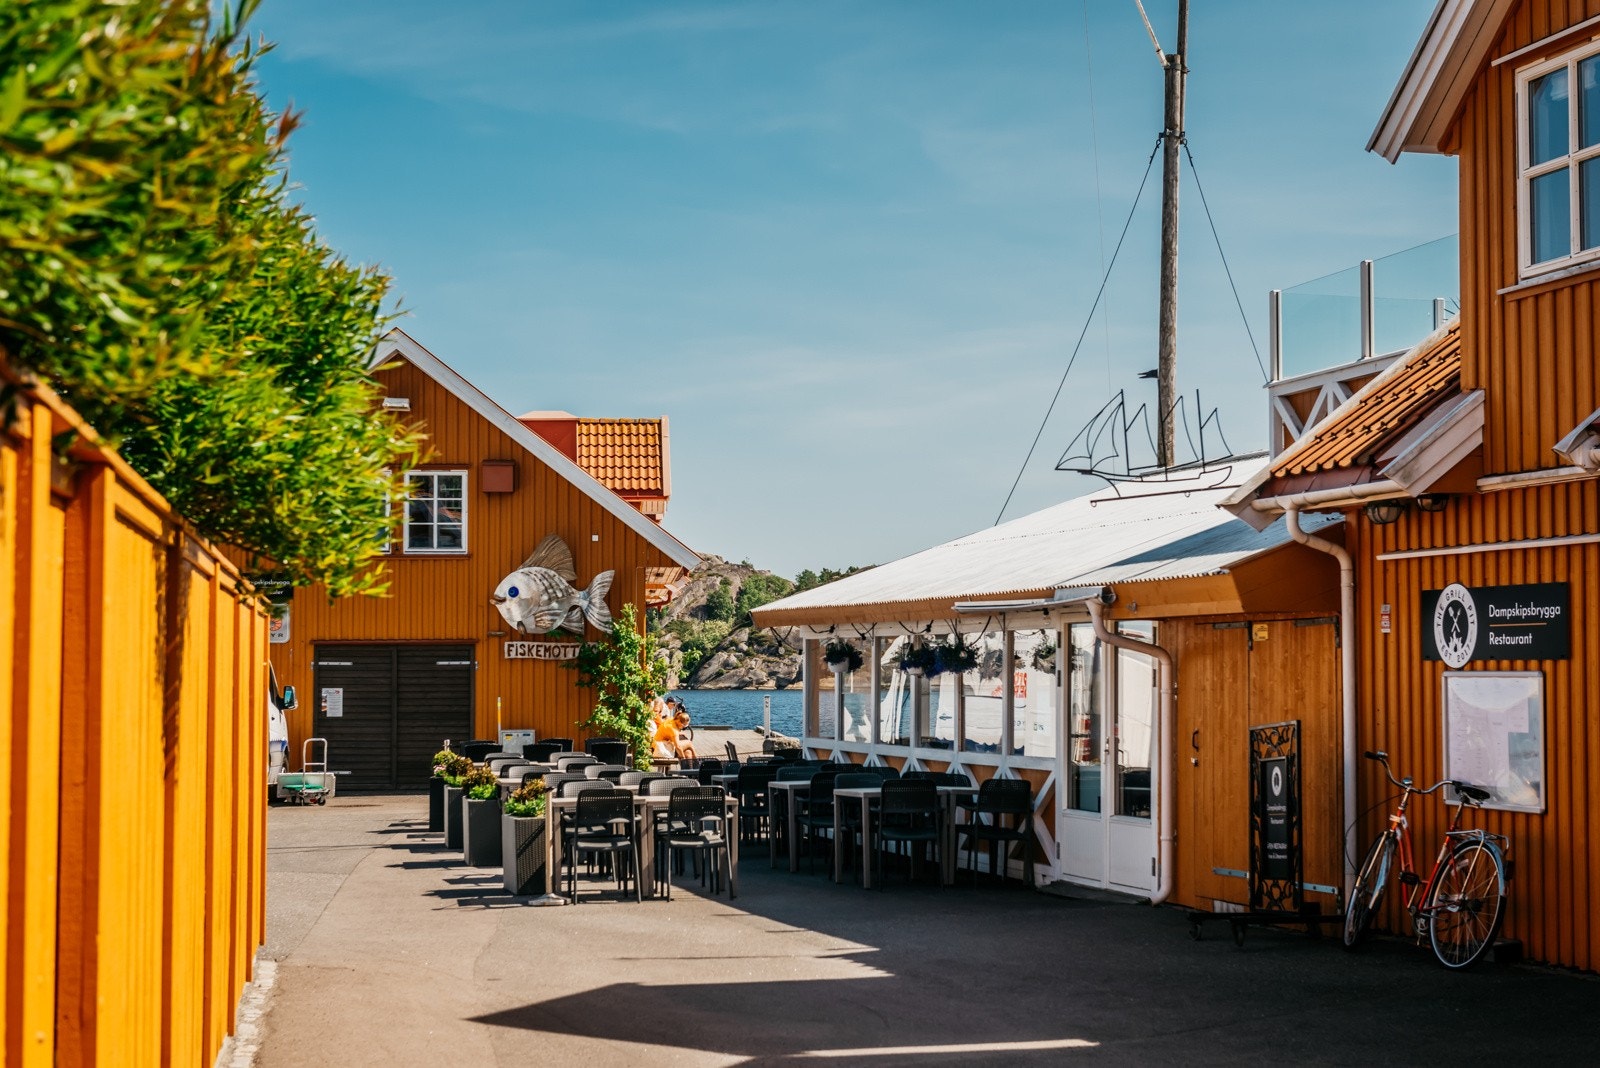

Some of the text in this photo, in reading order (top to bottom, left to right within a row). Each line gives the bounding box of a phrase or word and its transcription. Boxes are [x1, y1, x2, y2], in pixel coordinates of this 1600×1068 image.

[1446, 590, 1465, 602] GRILL
[1467, 605, 1475, 625] PIT
[1489, 602, 1561, 619] Dampskipsbrygga
[1489, 632, 1532, 645] Restaurant
[507, 643, 590, 658] FISKEMOTT
